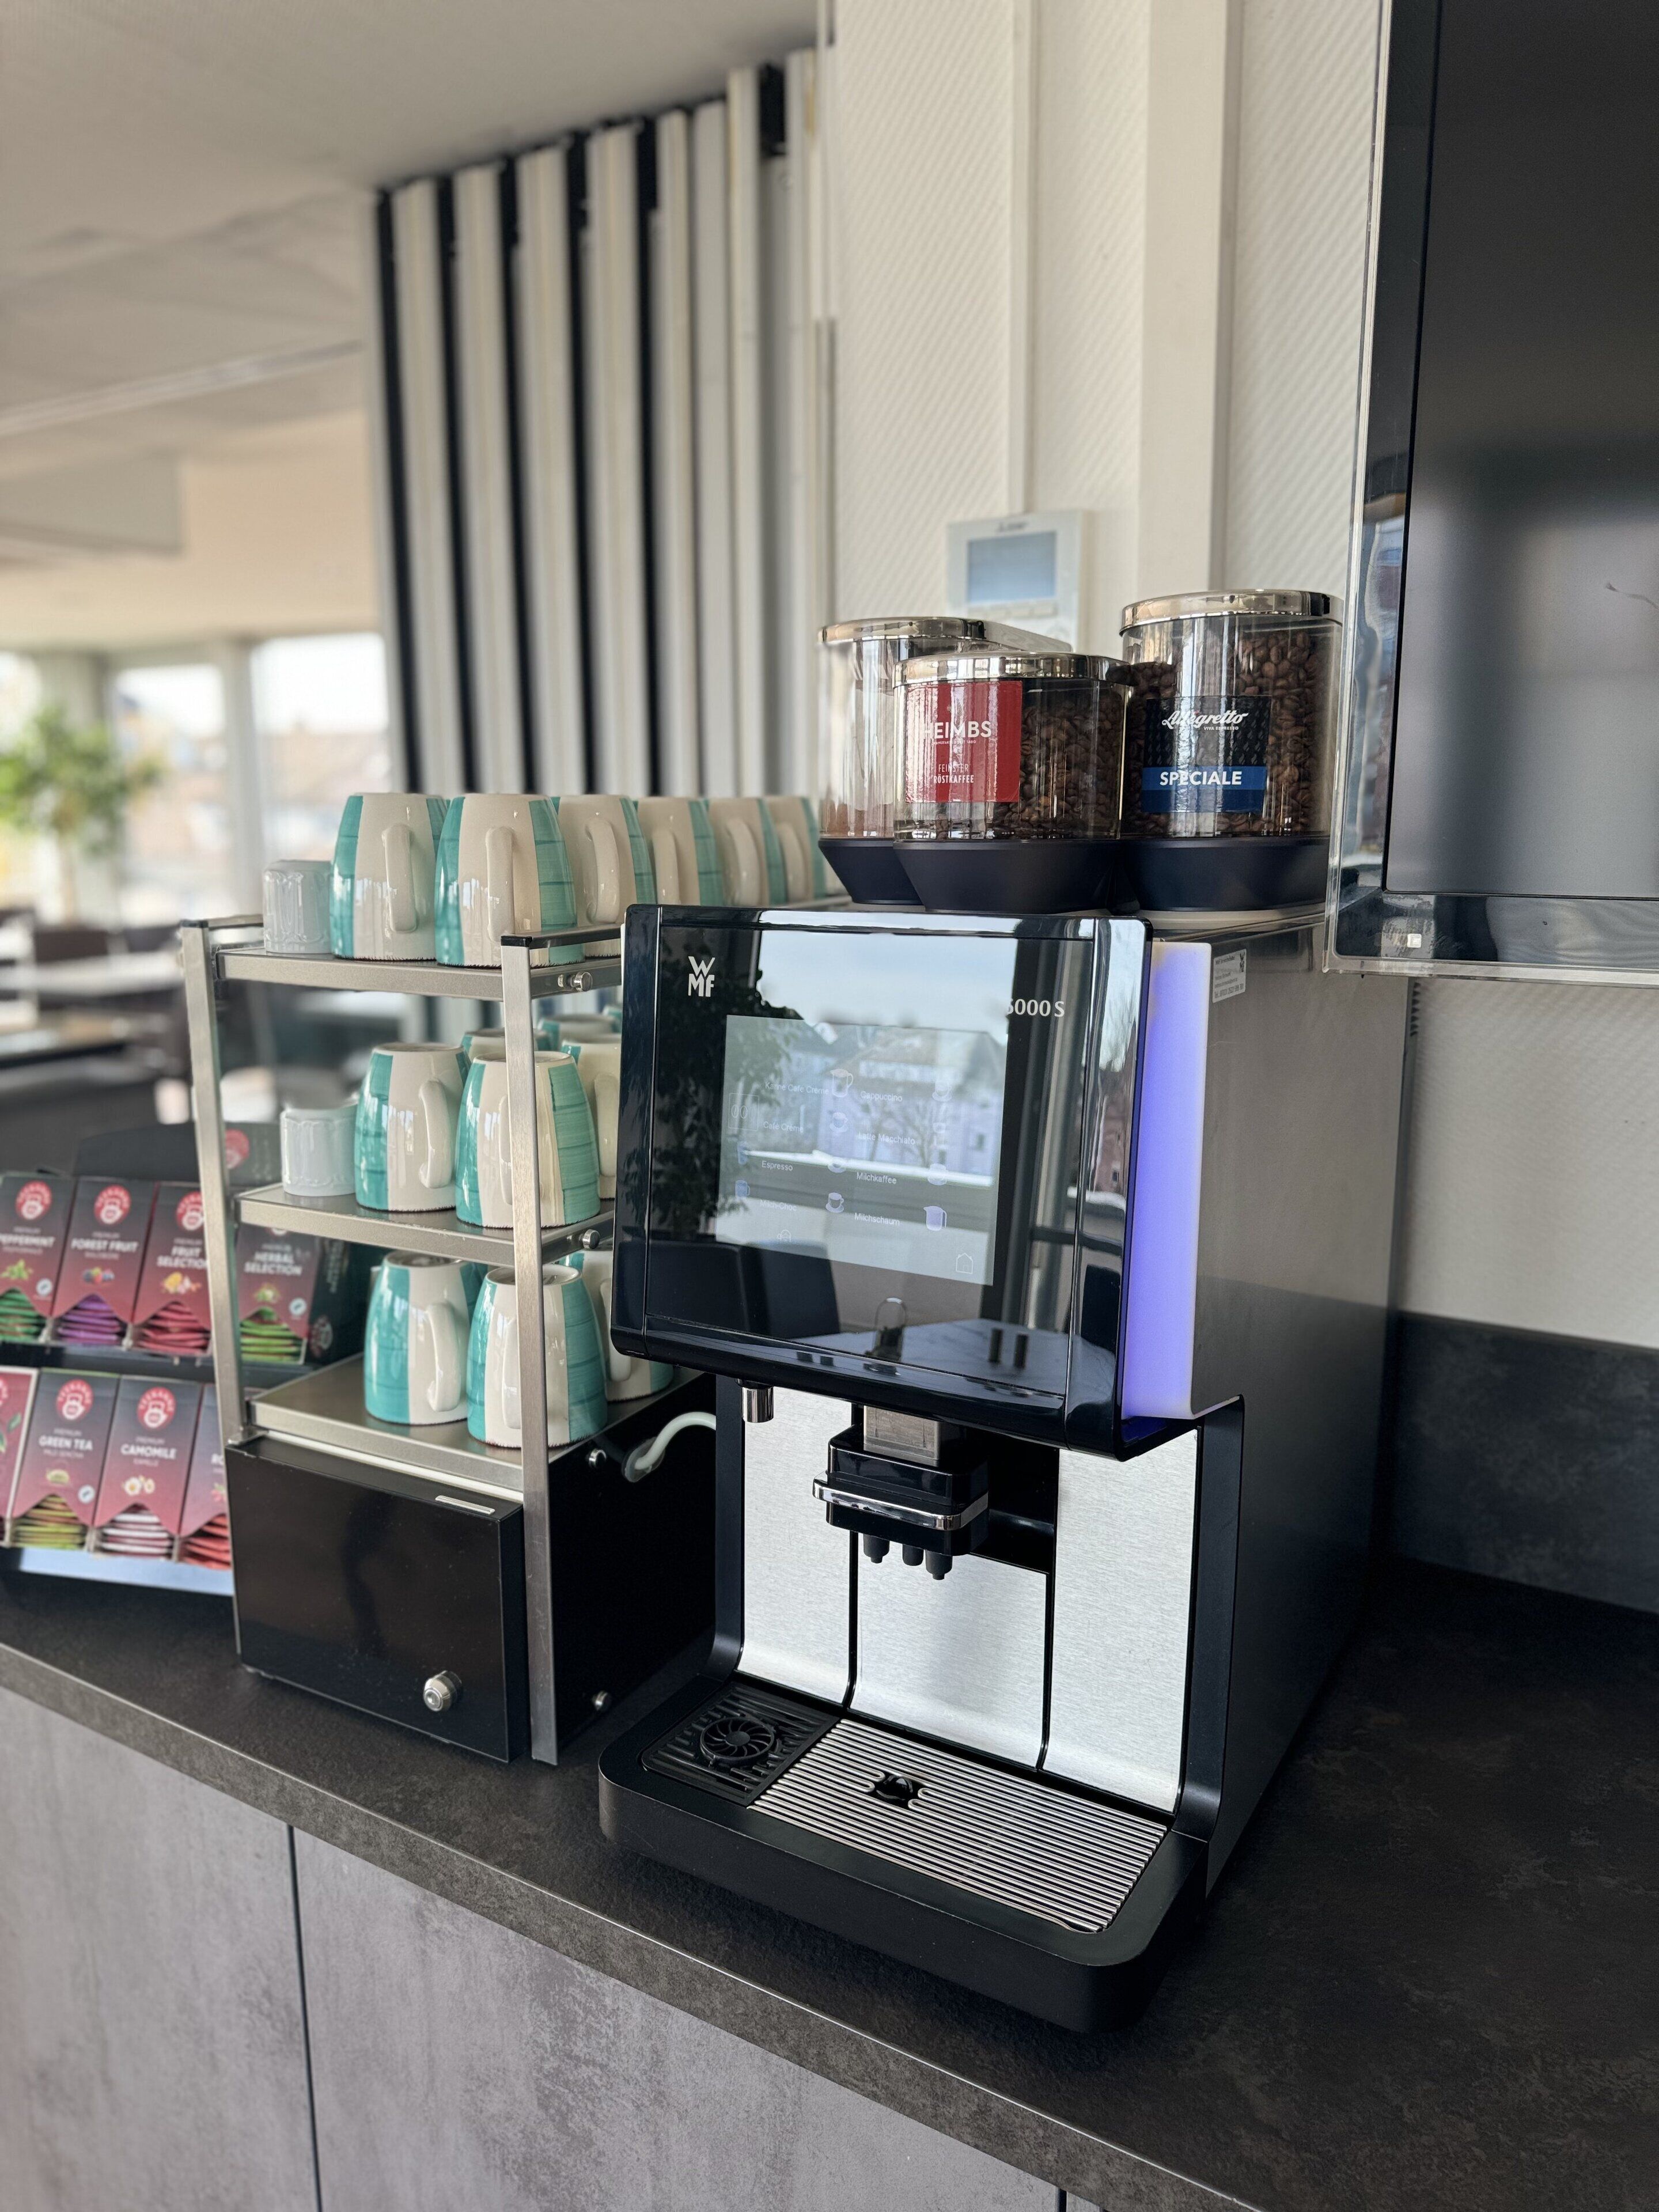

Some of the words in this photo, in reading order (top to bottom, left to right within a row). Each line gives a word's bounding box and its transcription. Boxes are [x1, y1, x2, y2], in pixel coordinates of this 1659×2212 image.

[923, 721, 992, 739] HEIMBS
[938, 764, 969, 773] FEINSTER
[933, 774, 975, 784] RÖSTKAFFEE
[1159, 771, 1243, 786] SPECIALE
[688, 956, 715, 997] WMF
[765, 1081, 786, 1091] Kanne
[861, 1090, 903, 1102] Cappuccino
[878, 1134, 916, 1145] Macchiato
[762, 1160, 793, 1171] Espresso
[857, 1172, 897, 1184] Milchkaffee
[760, 1200, 797, 1211] Milch-Choc
[854, 1213, 900, 1226] Milchschaum
[71, 1238, 108, 1251] FOREST
[108, 1241, 138, 1253] FRUIT
[171, 1246, 201, 1257] FRUIT
[157, 1256, 208, 1270] SELECTIO
[244, 1262, 303, 1276] SELECTION
[39, 1434, 73, 1449] GREEN
[73, 1438, 93, 1451] TEA
[121, 1444, 177, 1460] CAMOMILE
